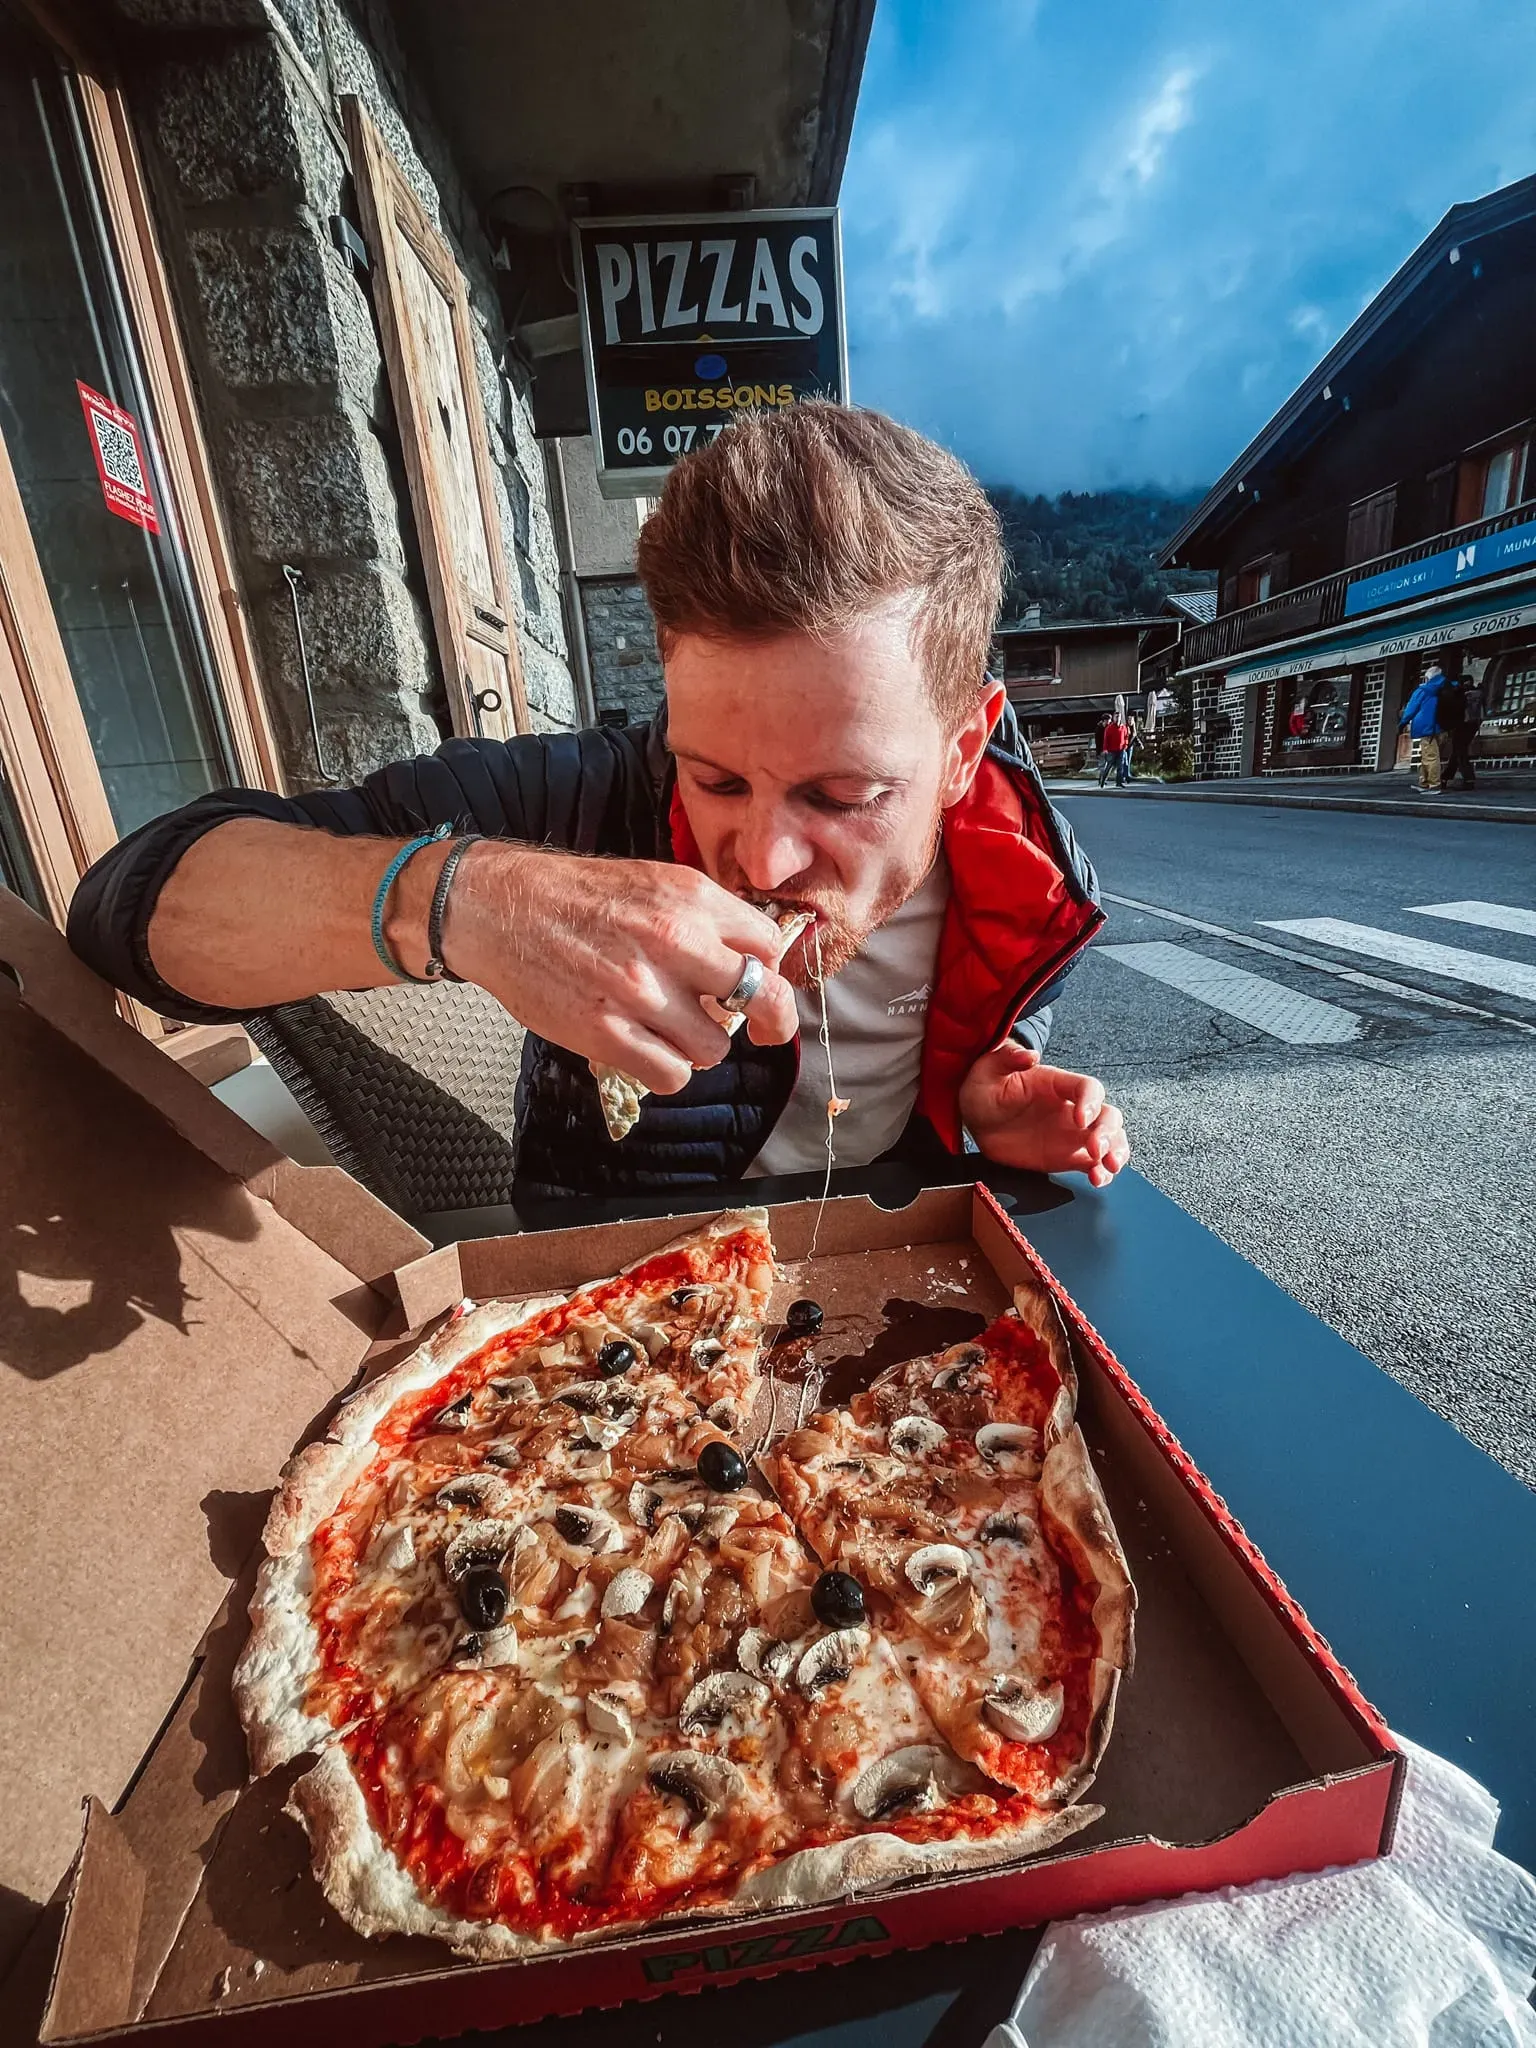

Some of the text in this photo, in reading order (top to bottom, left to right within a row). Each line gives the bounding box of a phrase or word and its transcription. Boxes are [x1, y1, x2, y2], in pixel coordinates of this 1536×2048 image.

[595, 236, 824, 345] PIZZAS
[645, 384, 795, 412] BOISSONS
[617, 423, 737, 455] 06 07 7
[1412, 571, 1426, 584] SKI
[1378, 612, 1522, 656] MONT-BLANC SPORTS
[1248, 667, 1280, 683] LOCATION
[1289, 660, 1314, 674] VENTE
[640, 1915, 890, 1983] PIZZA
